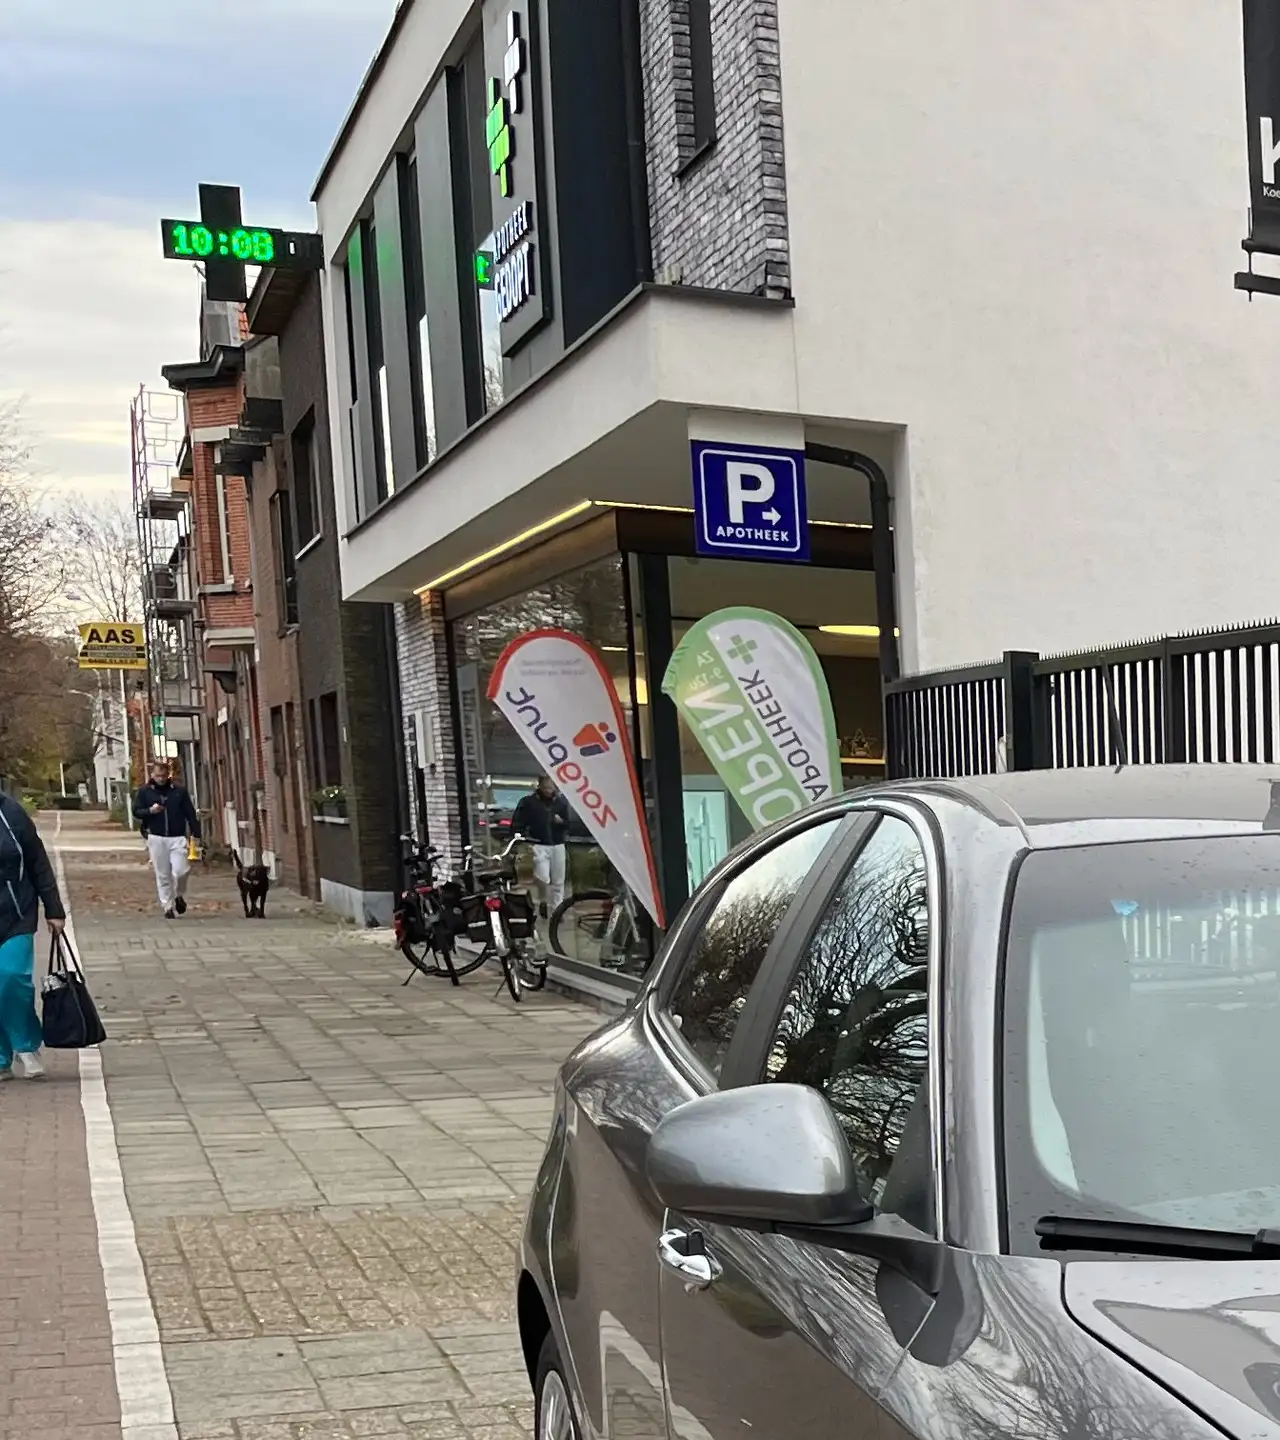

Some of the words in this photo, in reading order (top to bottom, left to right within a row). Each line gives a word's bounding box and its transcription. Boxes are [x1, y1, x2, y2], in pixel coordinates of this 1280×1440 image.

[171, 224, 275, 263] 10:08
[726, 461, 775, 524] P
[716, 525, 789, 542] APOTHEEK
[87, 628, 135, 644] AAS
